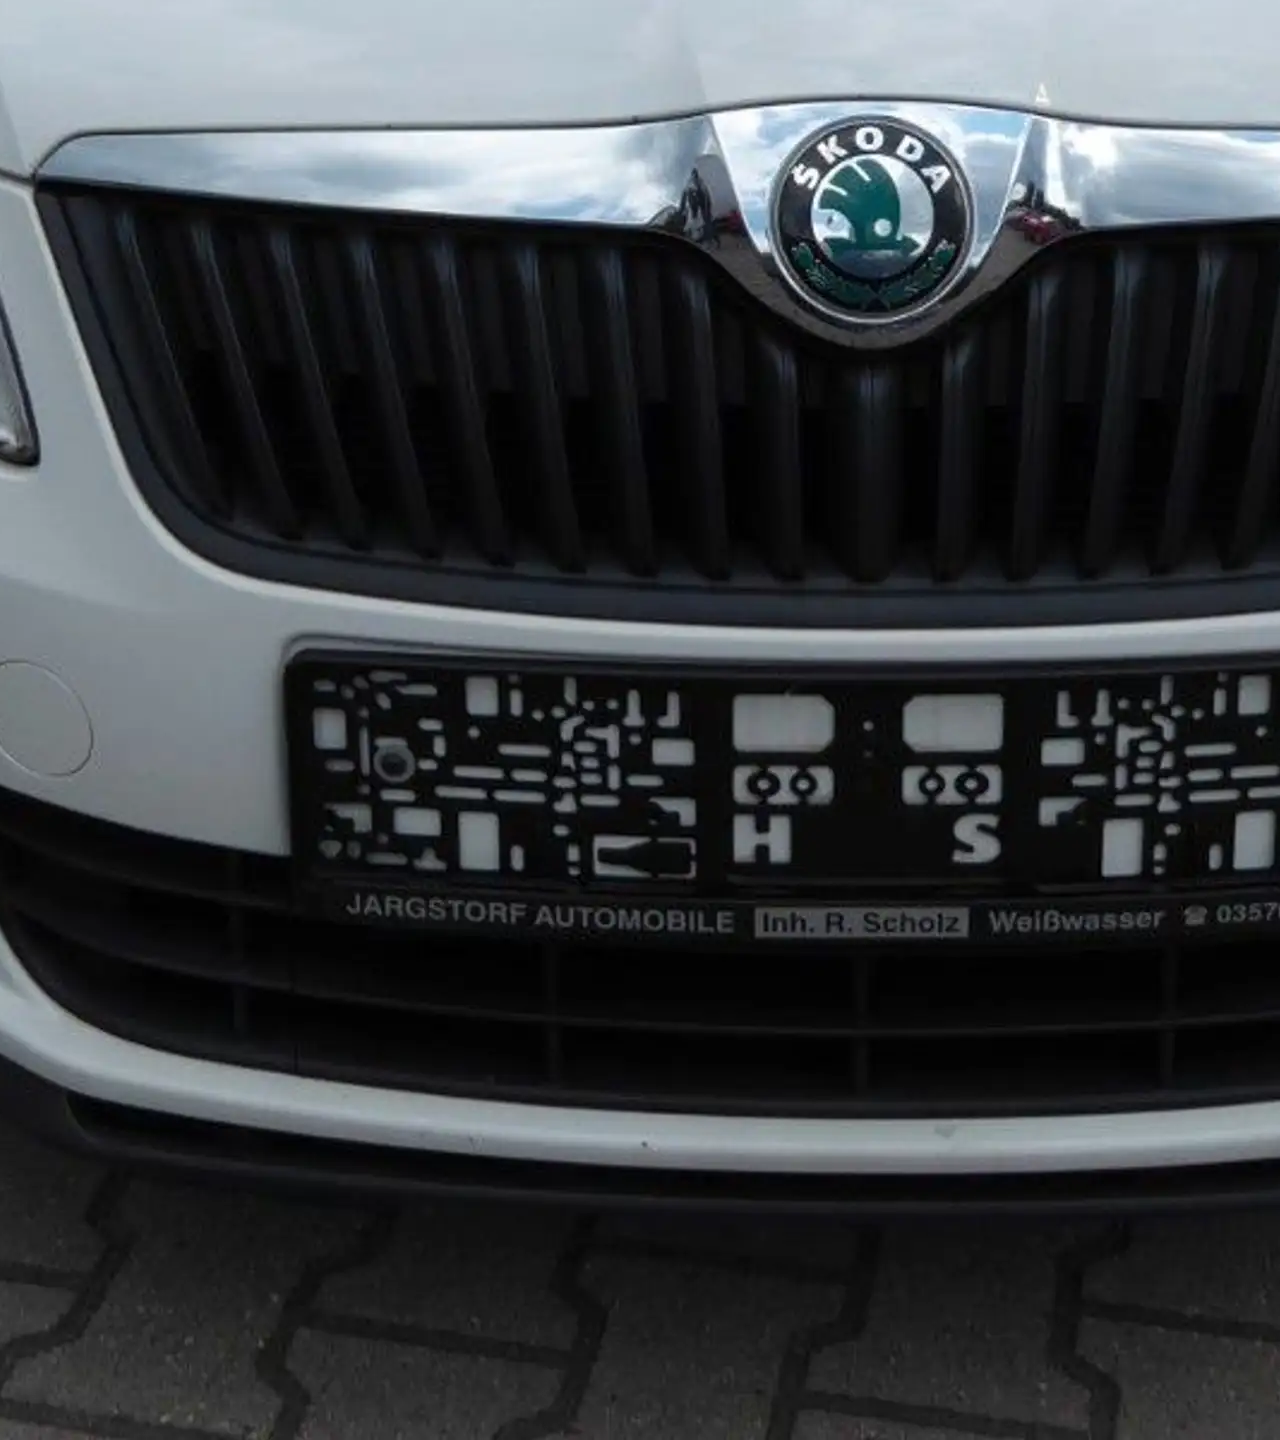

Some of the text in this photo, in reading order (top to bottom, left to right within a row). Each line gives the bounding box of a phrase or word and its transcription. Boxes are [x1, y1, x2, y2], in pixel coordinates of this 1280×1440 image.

[346, 893, 527, 924] JARGSTORF
[535, 905, 734, 934] AUTOMOBILE
[762, 912, 815, 933] Inh.
[825, 912, 852, 933] R.
[863, 911, 960, 934] Scholz
[988, 909, 1166, 934] Weißwasser
